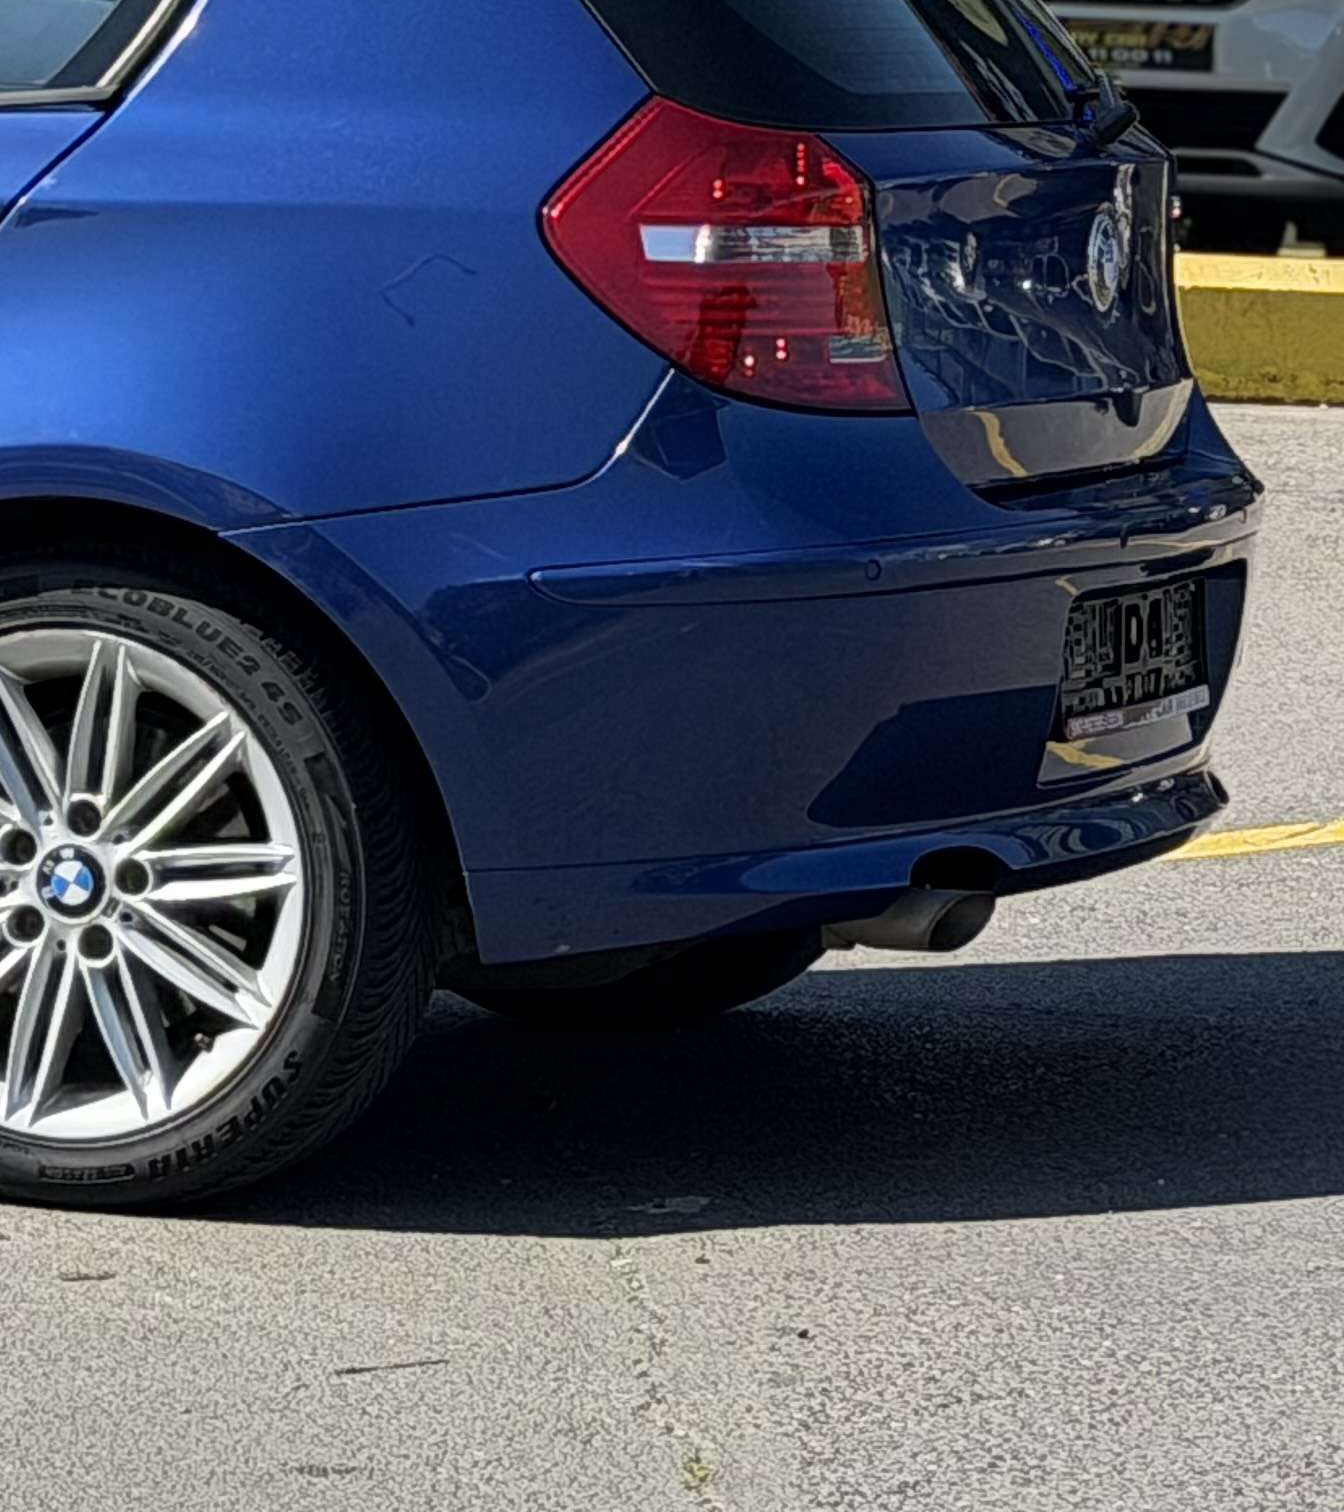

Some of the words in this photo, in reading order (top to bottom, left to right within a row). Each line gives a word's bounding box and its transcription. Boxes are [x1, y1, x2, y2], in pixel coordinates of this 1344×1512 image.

[70, 578, 262, 678] ECOBLUE2
[261, 680, 305, 727] 4S
[147, 1049, 303, 1179] SUPERIA
